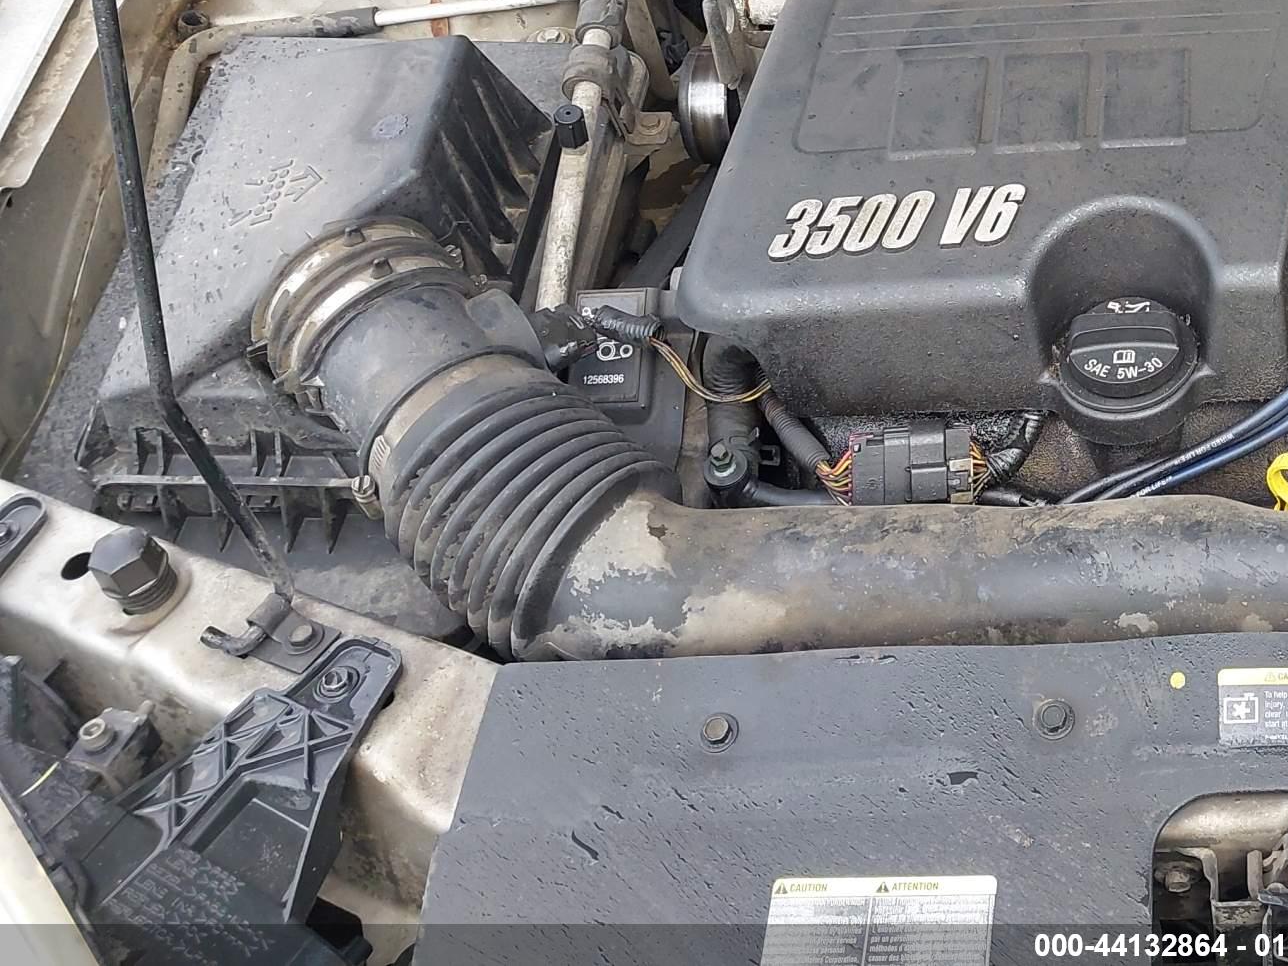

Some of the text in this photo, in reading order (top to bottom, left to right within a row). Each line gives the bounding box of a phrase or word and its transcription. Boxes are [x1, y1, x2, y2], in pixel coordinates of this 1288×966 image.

[767, 183, 1027, 262] 3500 V6
[1084, 357, 1164, 380] SAE 5W-30
[583, 373, 625, 385] 12568396
[1264, 690, 1272, 698] To
[1273, 690, 1288, 700] help
[1264, 710, 1282, 718] clear
[1264, 720, 1281, 728] start
[789, 883, 829, 893] CAUTION
[891, 881, 940, 892] ATTENTION
